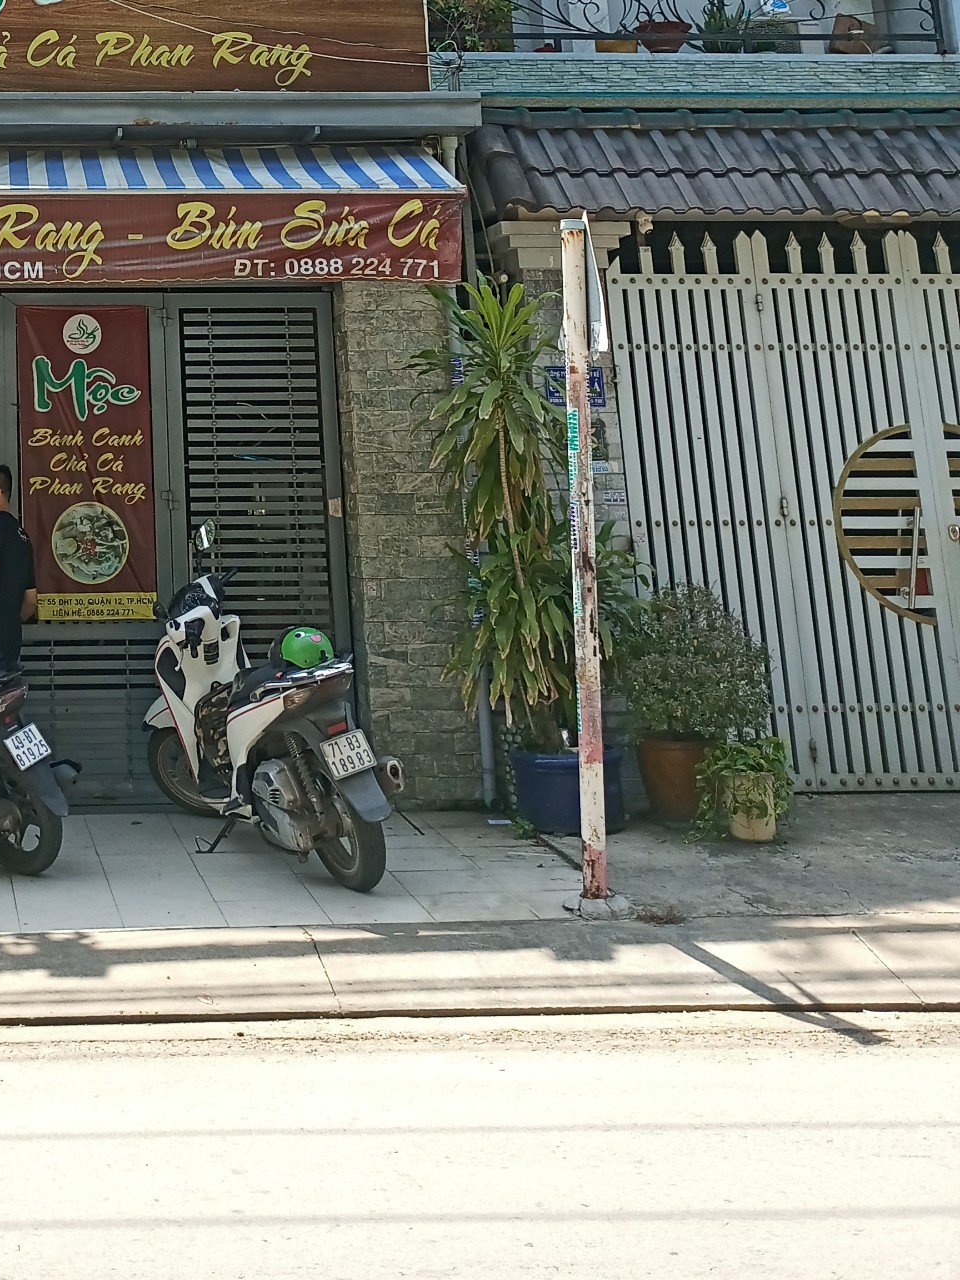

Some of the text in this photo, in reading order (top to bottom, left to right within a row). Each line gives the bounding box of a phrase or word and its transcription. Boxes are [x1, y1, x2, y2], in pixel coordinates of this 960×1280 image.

[26, 29, 78, 68] Cá
[95, 30, 195, 68] Phan
[211, 31, 313, 87] Rang
[166, 201, 264, 250] Bún
[280, 199, 370, 250] Sứa
[387, 199, 442, 251] Cá
[233, 257, 441, 278] ĐT: 0888 224 771
[32, 355, 142, 422] Mộc
[27, 427, 145, 447] Bánh Canh
[49, 452, 124, 472] Chả Cá
[29, 476, 147, 505] Phan Rang
[106, 609, 120, 617] 224
[121, 608, 136, 617] 771
